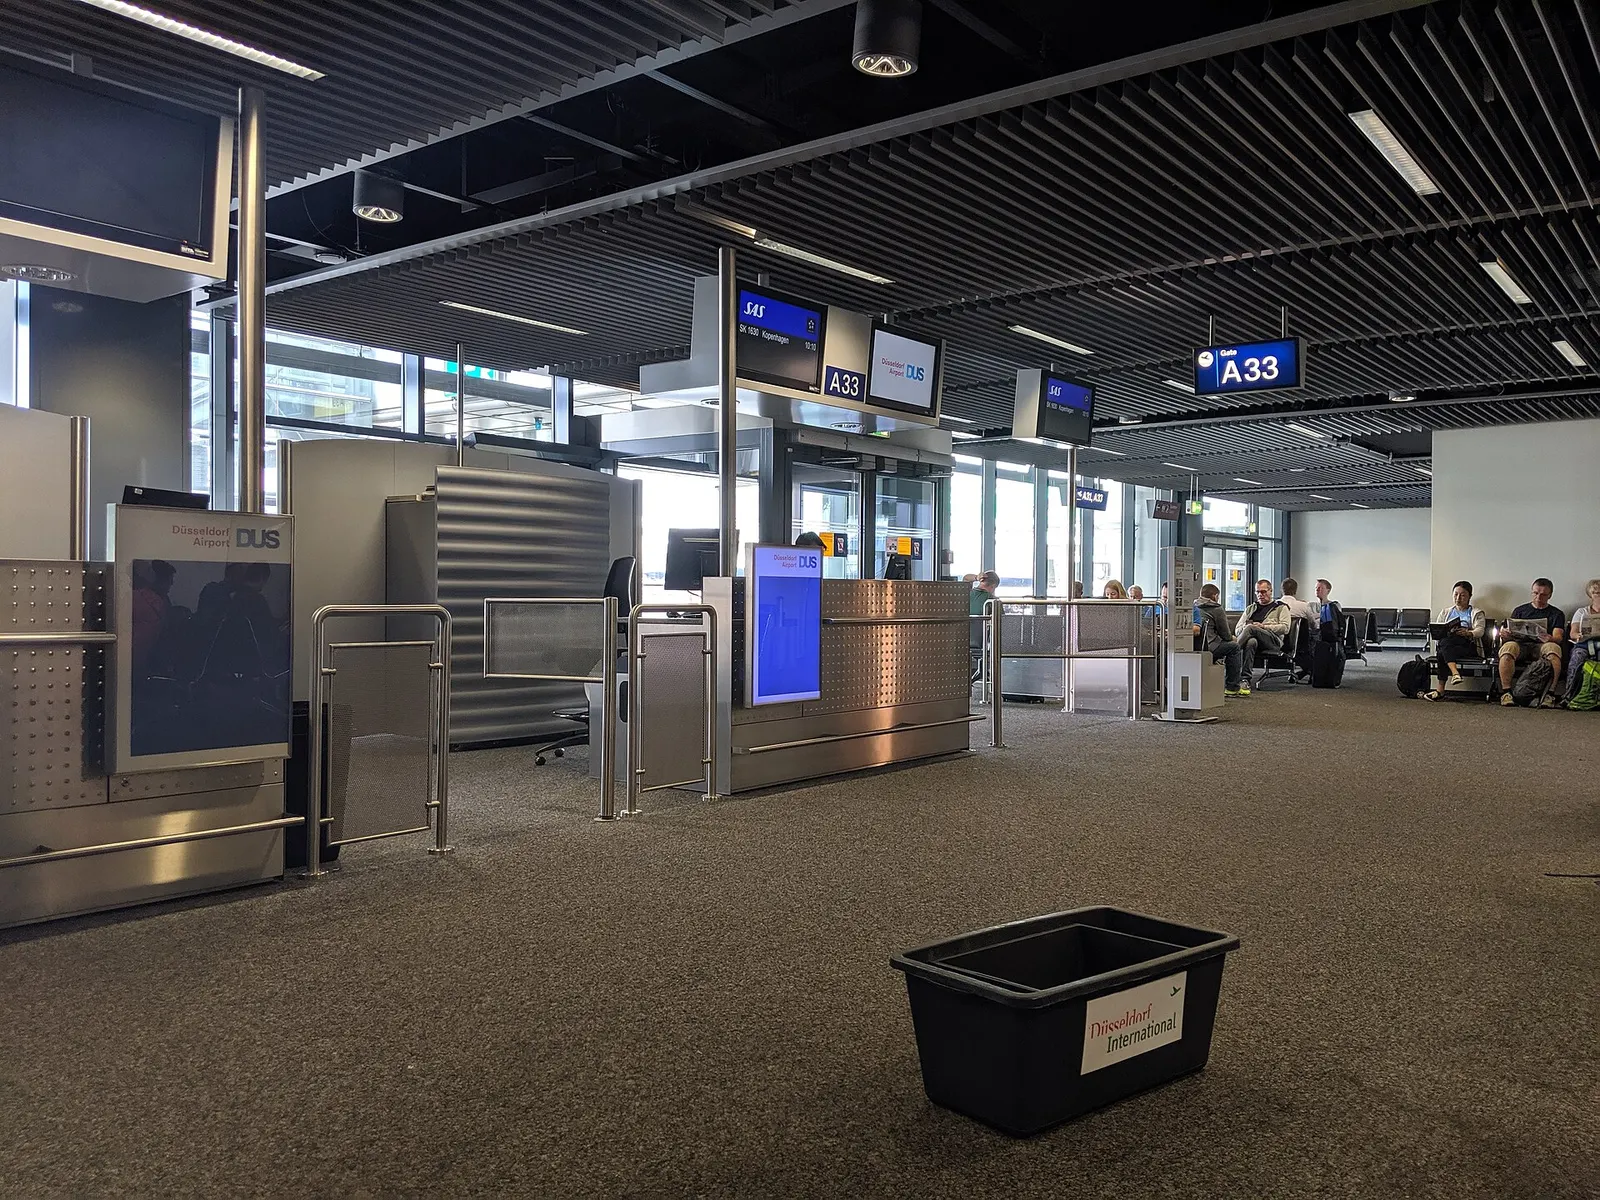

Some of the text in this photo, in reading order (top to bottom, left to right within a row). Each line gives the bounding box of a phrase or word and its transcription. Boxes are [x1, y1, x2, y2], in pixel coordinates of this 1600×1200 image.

[743, 301, 766, 318] SAS
[739, 323, 789, 344] SK 1630 Kopenhagen
[805, 341, 817, 351] 10:10
[881, 357, 905, 369] Düsseldorf
[1221, 355, 1279, 384] A33
[888, 367, 905, 378] Airport
[905, 364, 925, 381] DUS
[829, 371, 859, 396] A33
[1049, 385, 1062, 397] SAS
[172, 525, 231, 537] Düsseldorf
[236, 527, 281, 549] DUS
[193, 537, 231, 549] Airport
[799, 555, 816, 568] DUS
[1089, 1002, 1153, 1040] Düsseldorf
[1106, 1012, 1177, 1054] International
